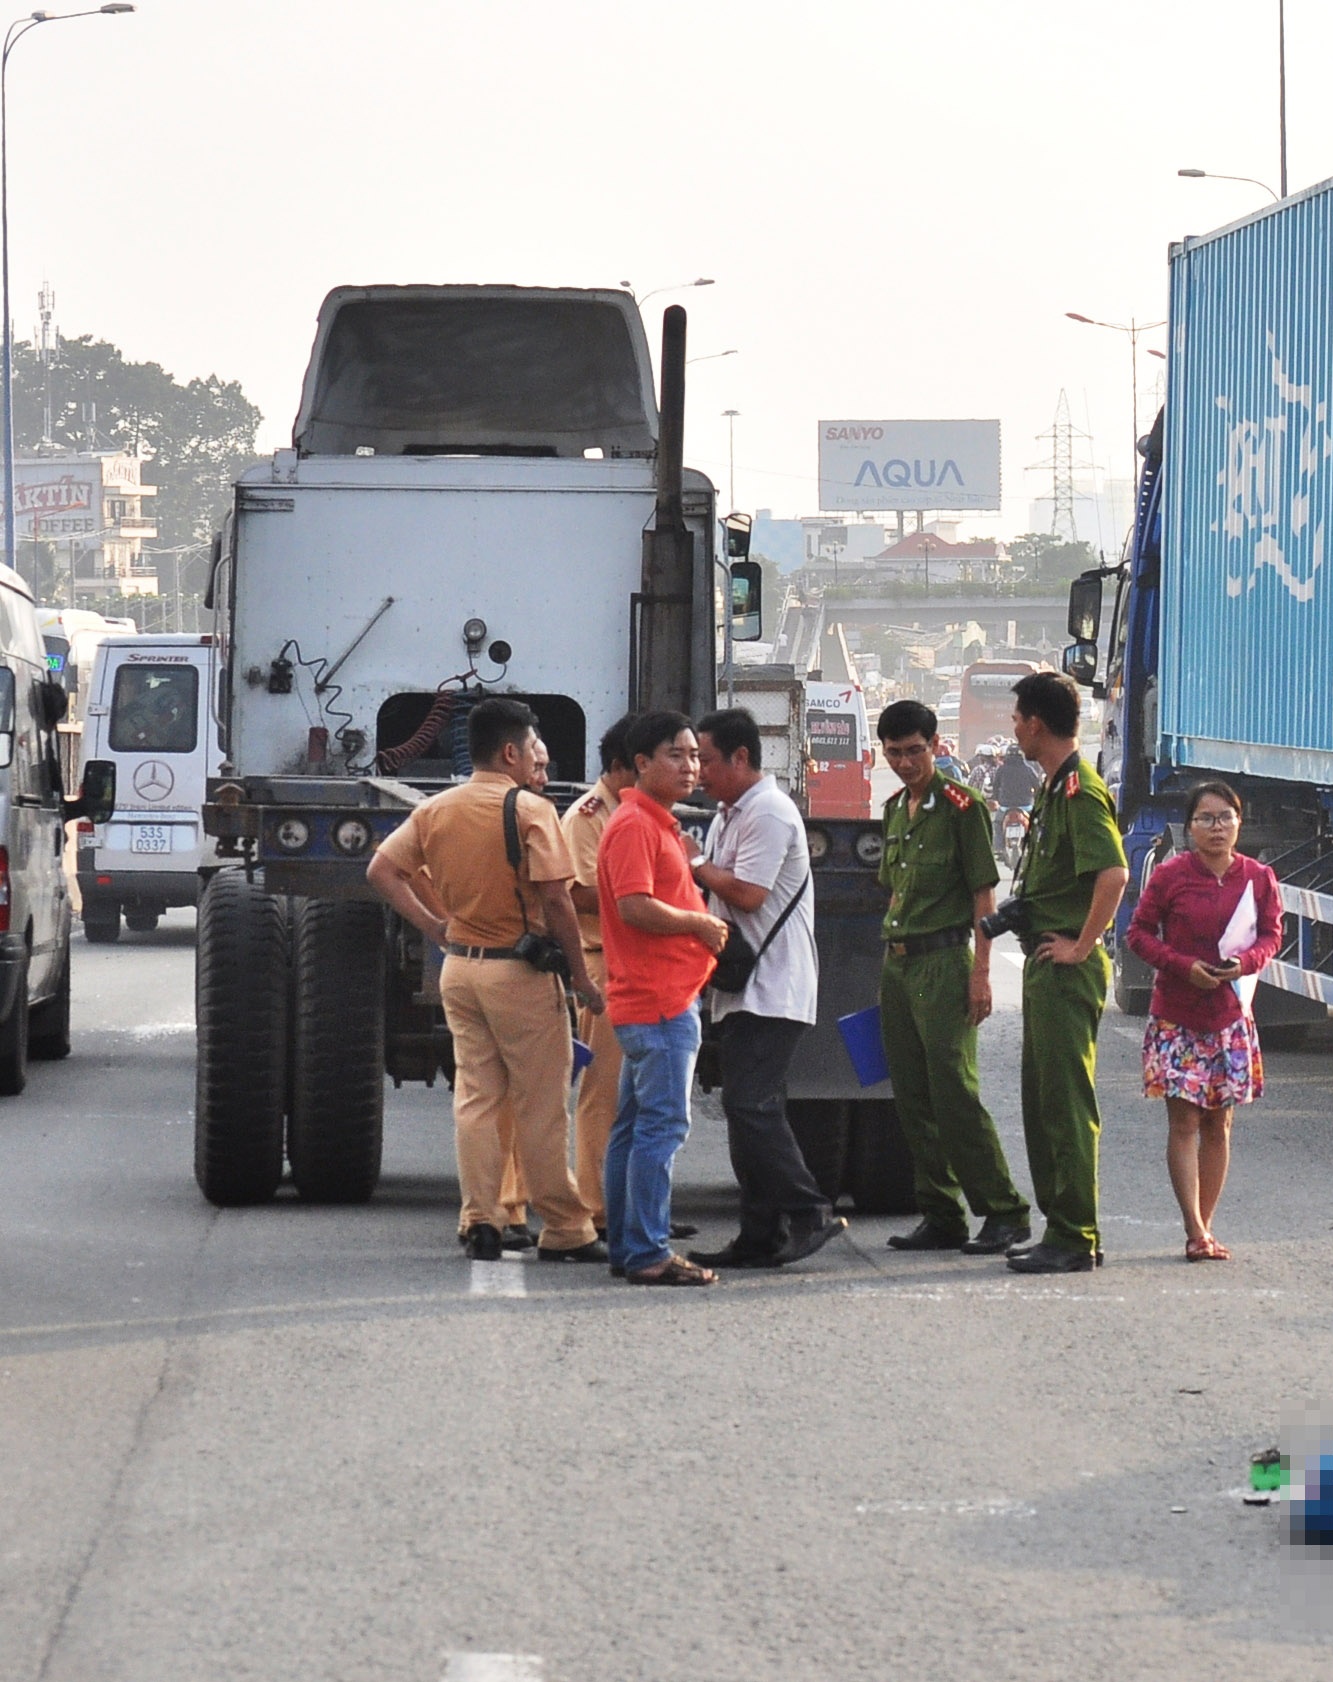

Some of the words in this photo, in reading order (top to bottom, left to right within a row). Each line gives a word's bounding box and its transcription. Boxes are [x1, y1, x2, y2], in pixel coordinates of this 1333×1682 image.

[825, 427, 885, 441] SANYO
[853, 459, 965, 487] AQUA
[28, 518, 94, 532] COFFEE
[805, 699, 840, 708] SAMCO
[140, 827, 163, 838] 53S
[136, 839, 166, 850] 0337
